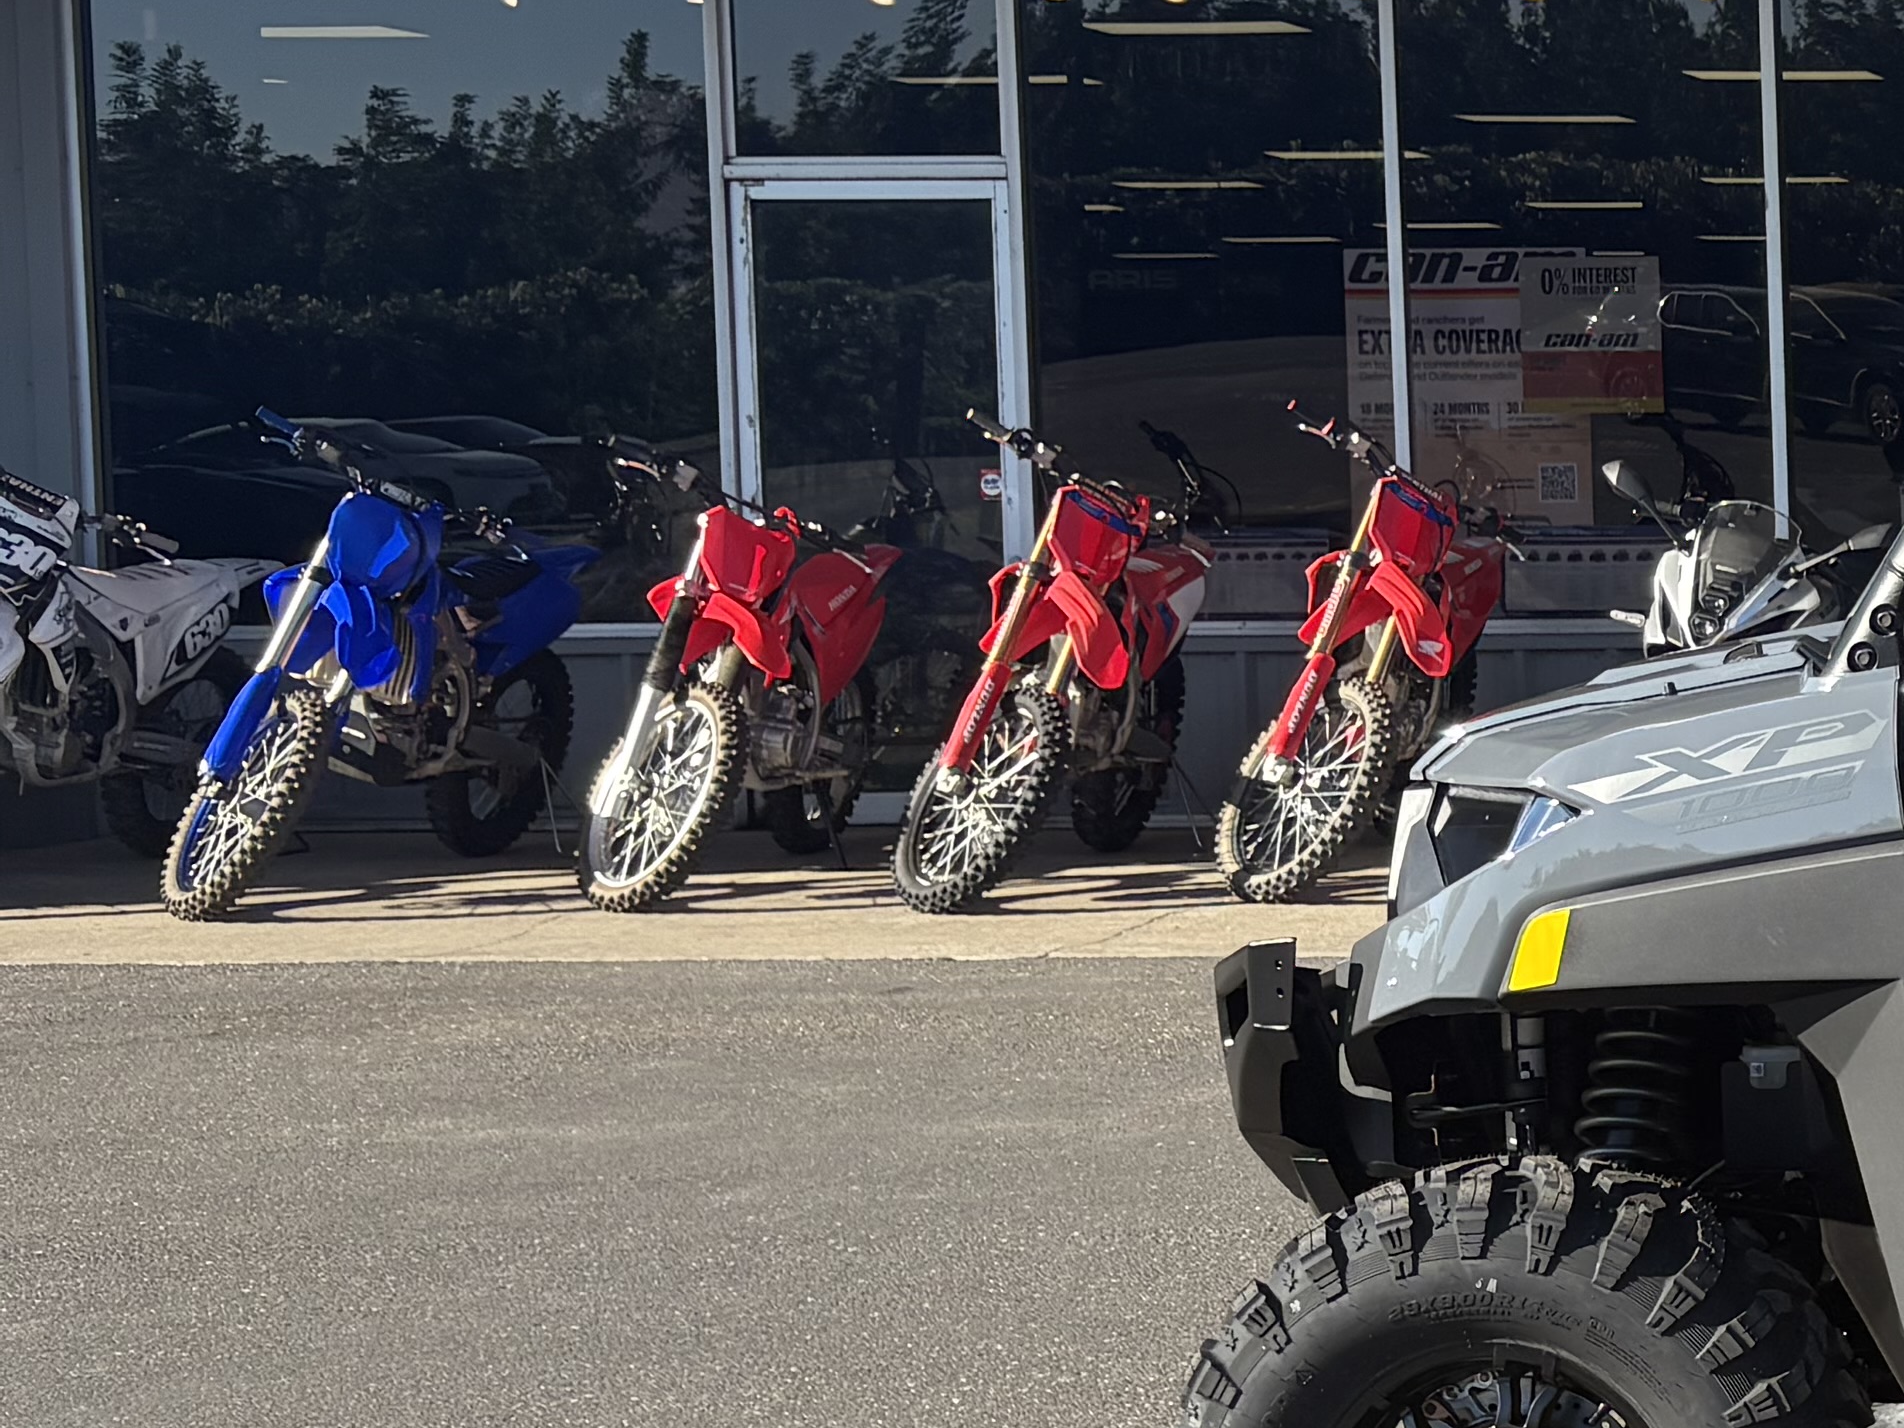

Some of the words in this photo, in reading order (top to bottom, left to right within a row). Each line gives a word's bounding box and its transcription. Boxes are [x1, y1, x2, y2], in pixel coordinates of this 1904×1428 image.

[1540, 267, 1569, 295] 0%
[1572, 266, 1637, 284] INTEREST
[1357, 329, 1426, 355] EXA
[828, 584, 858, 612] HONDA
[183, 602, 231, 660] 630
[1621, 709, 1882, 802] XP
[1677, 765, 1862, 821] 1000
